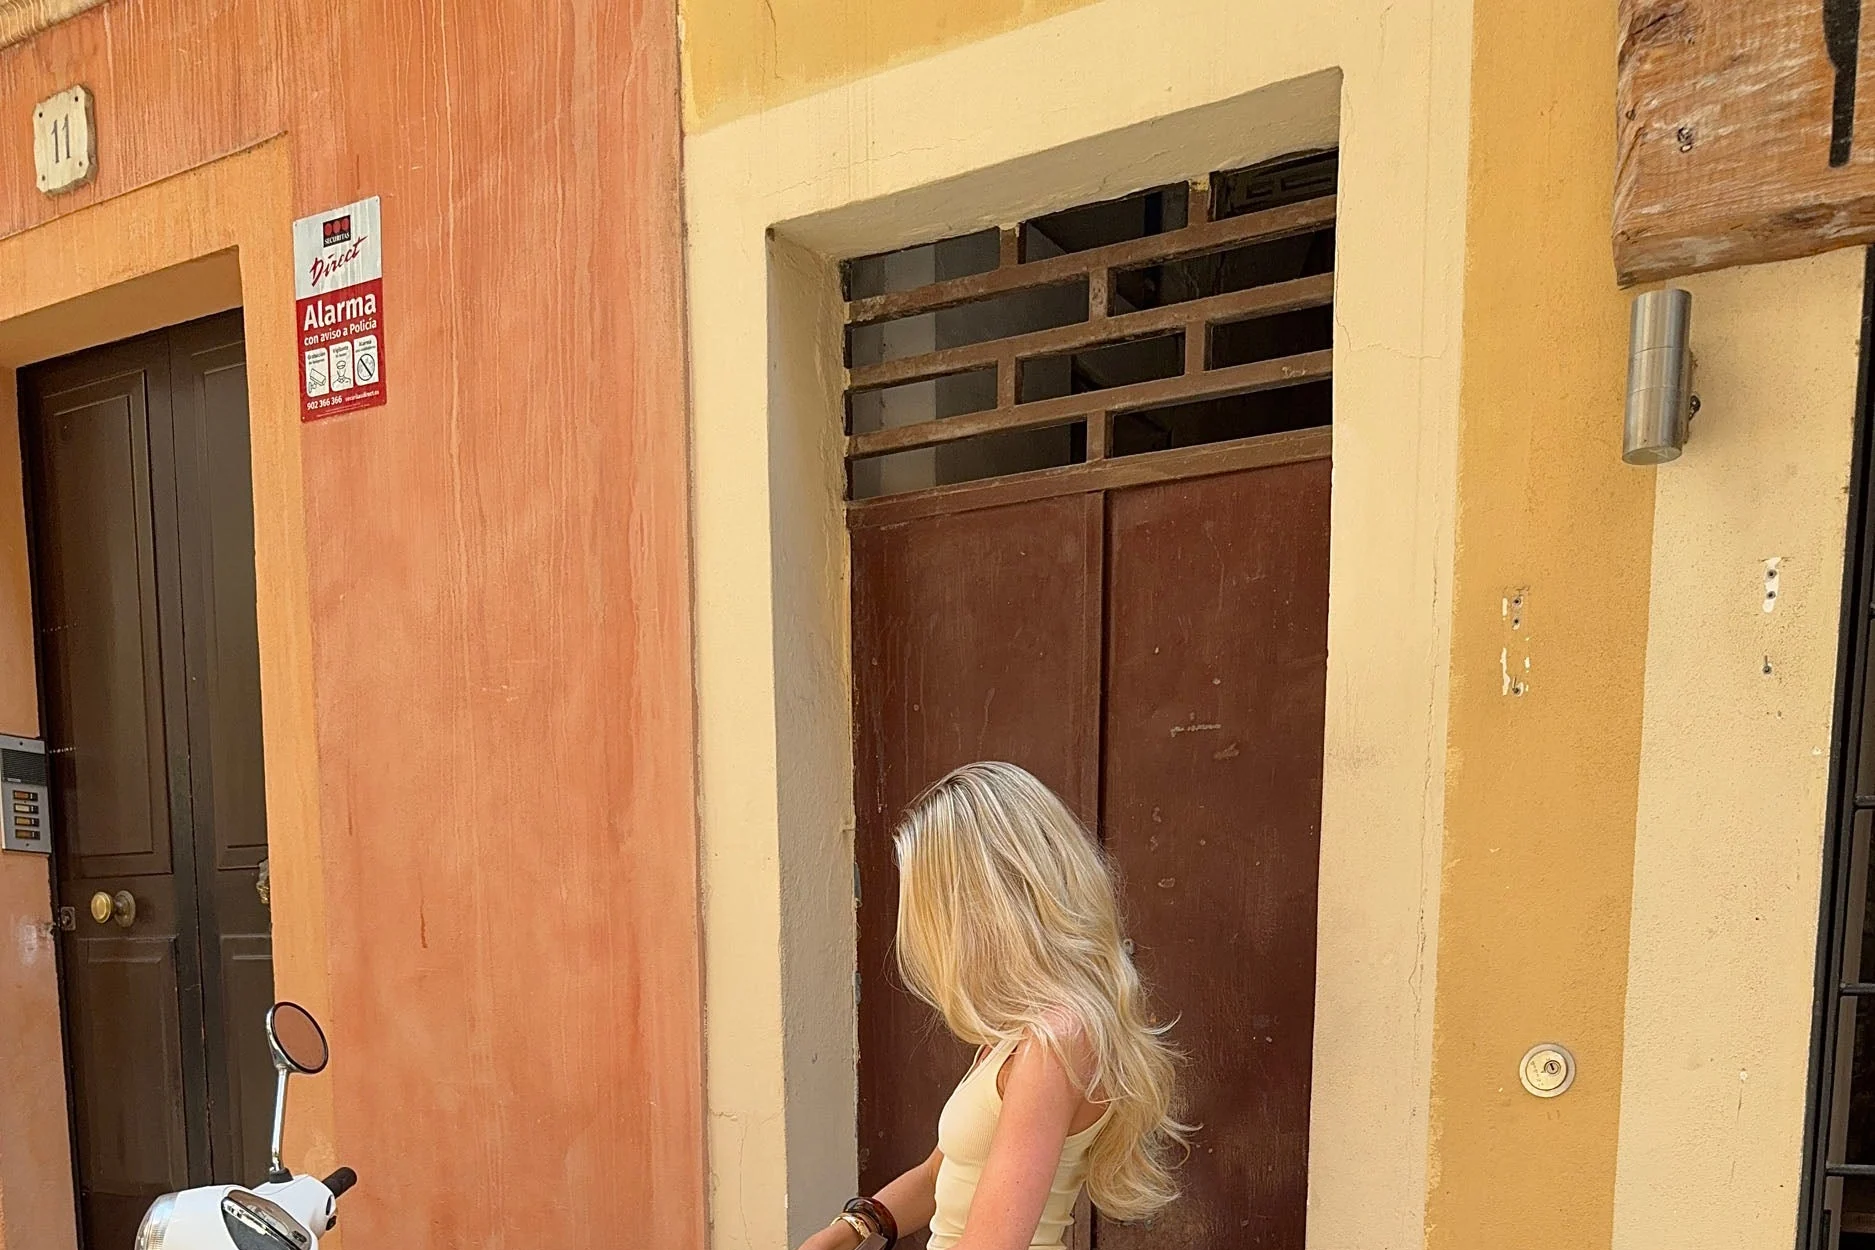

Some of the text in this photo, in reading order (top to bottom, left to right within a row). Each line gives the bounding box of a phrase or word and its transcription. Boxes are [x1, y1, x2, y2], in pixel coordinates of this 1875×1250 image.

[51, 113, 71, 164] 11
[324, 232, 350, 245] SECURITAS
[309, 235, 368, 287] Direct
[303, 293, 377, 331] Alarma
[304, 317, 377, 346] con aviso a Policía
[306, 400, 319, 411] 902
[319, 398, 331, 408] 366
[331, 395, 343, 406] 366
